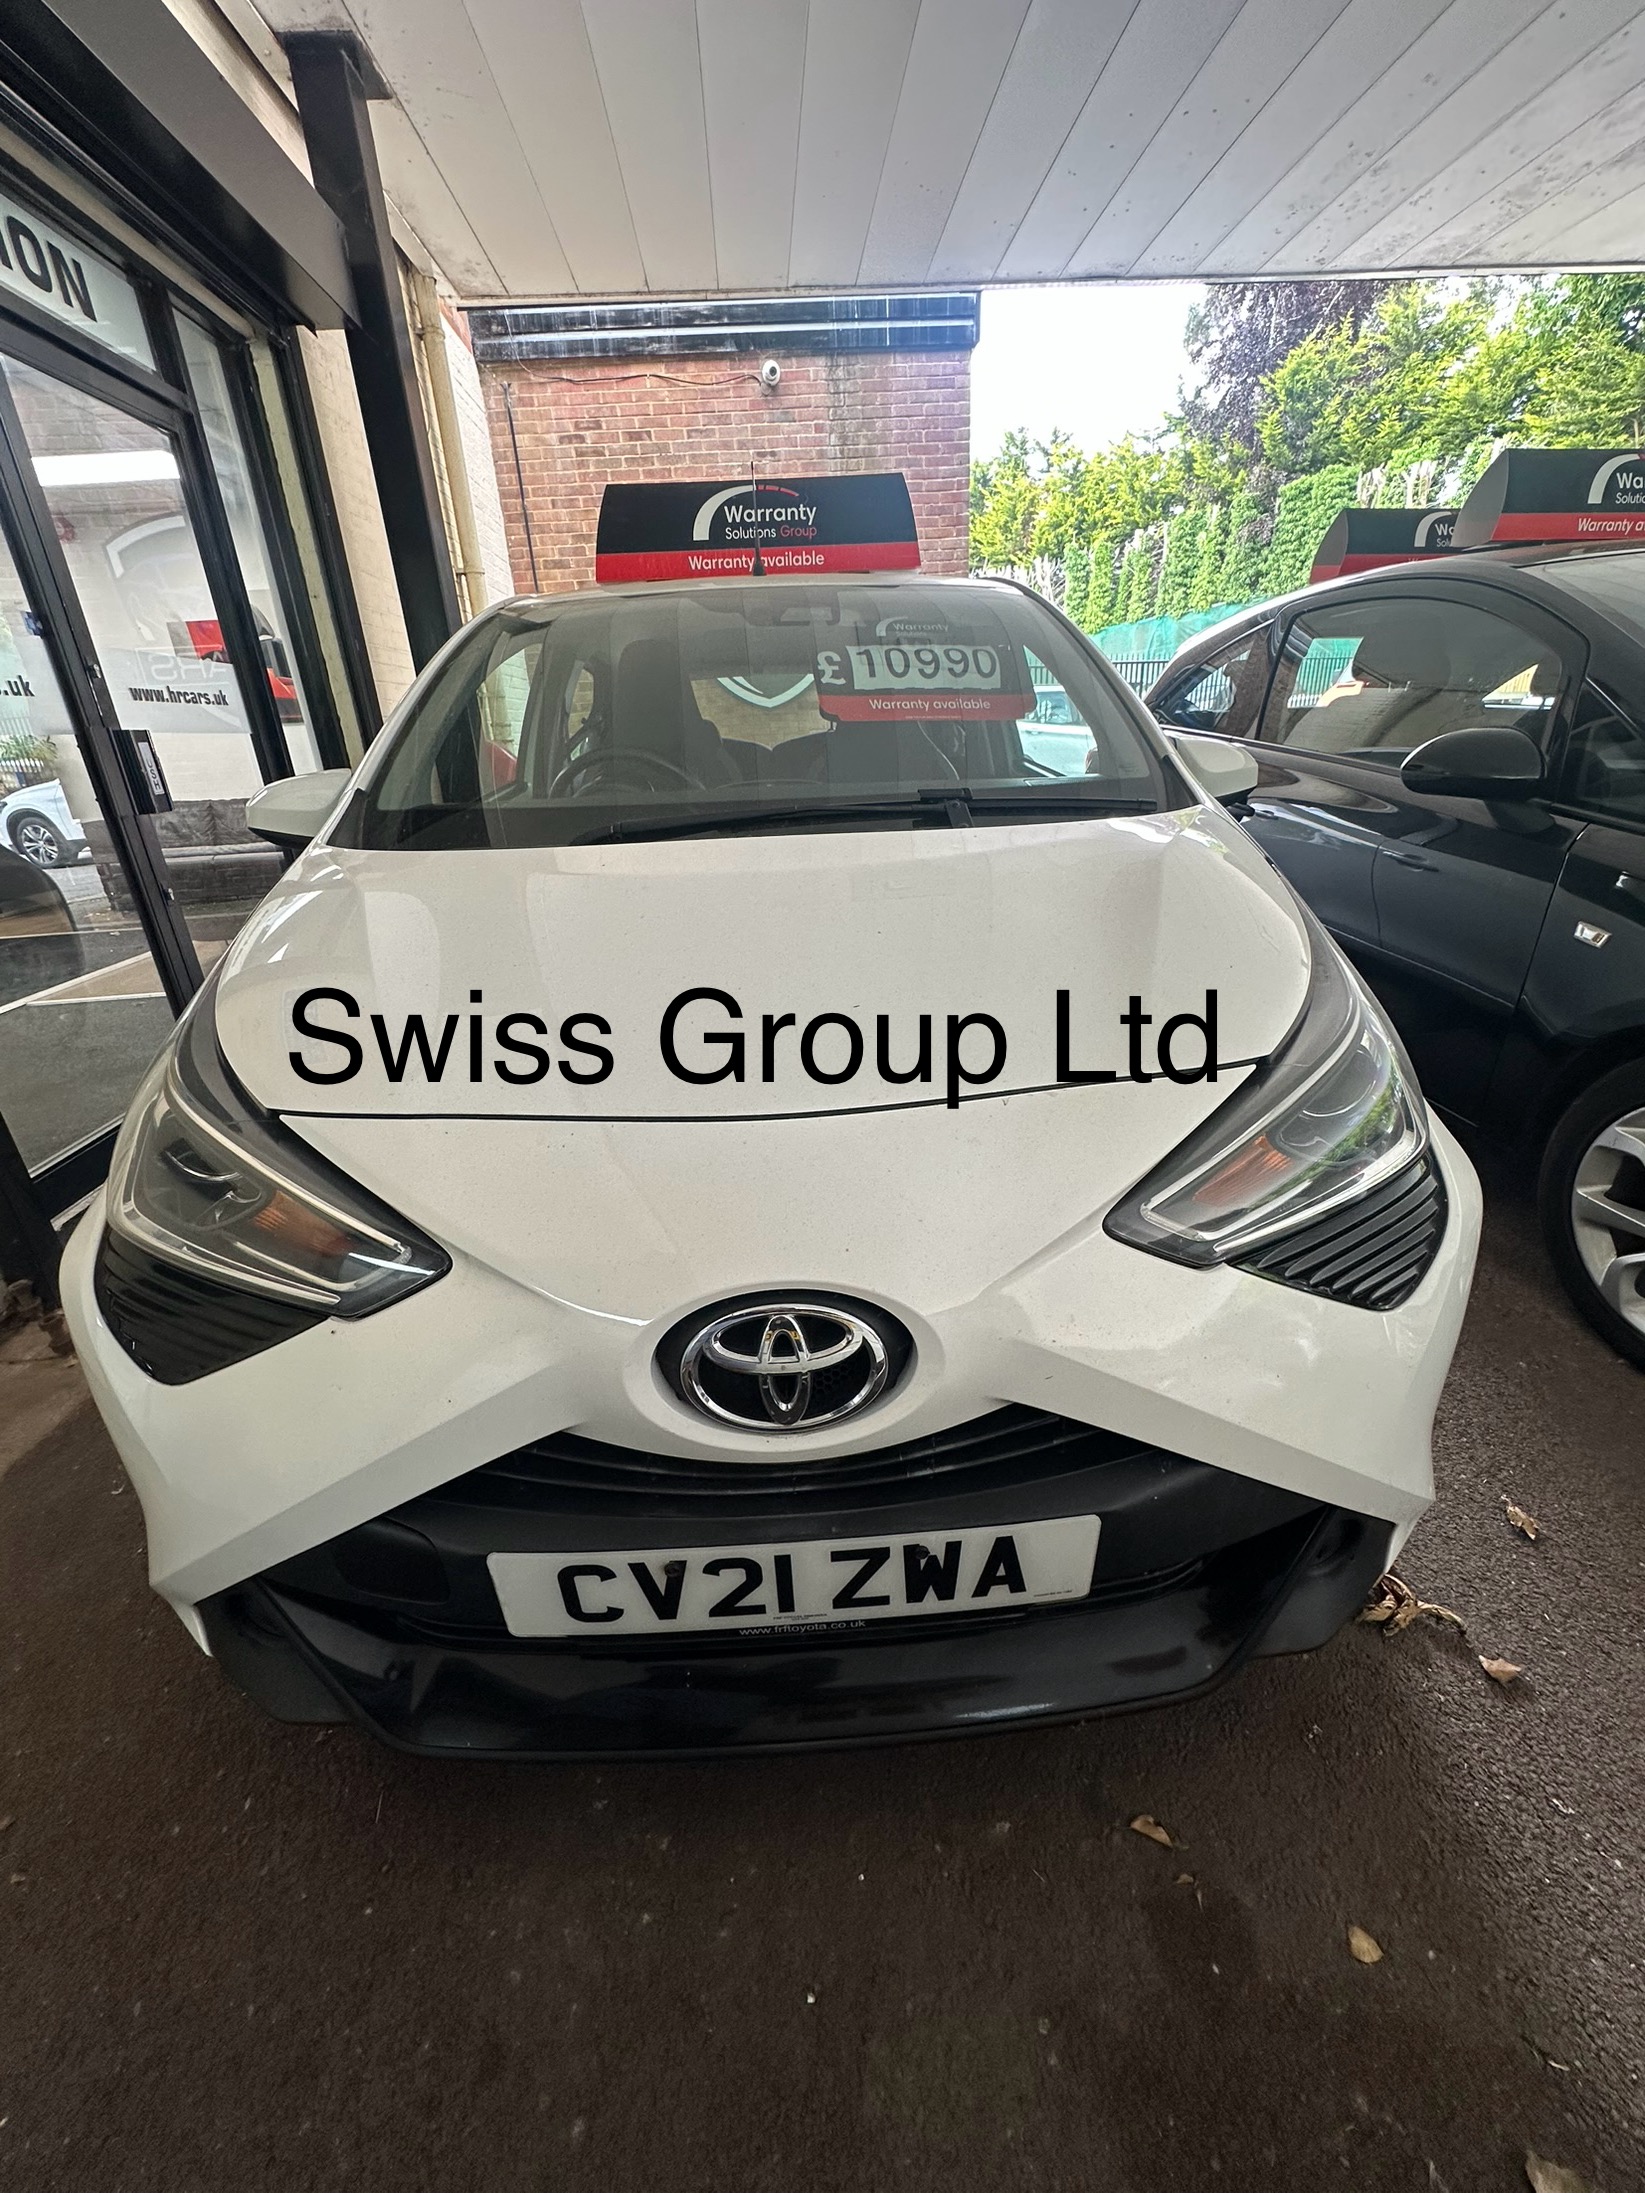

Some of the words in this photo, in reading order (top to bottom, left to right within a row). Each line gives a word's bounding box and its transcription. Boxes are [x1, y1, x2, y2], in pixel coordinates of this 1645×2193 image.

[724, 504, 817, 526] Warranty
[725, 527, 776, 540] Solutions
[780, 524, 817, 539] Group
[1578, 517, 1634, 535] Warranty
[688, 554, 755, 571] Warranty
[760, 550, 825, 567] available
[856, 648, 997, 679] 10990
[0, 674, 36, 697] .uk
[128, 685, 230, 706] www.hrcars.uk
[869, 699, 929, 711] Warranty
[933, 699, 991, 709] available
[557, 1554, 796, 1624] CV21
[829, 1535, 1028, 1609] ZWA
